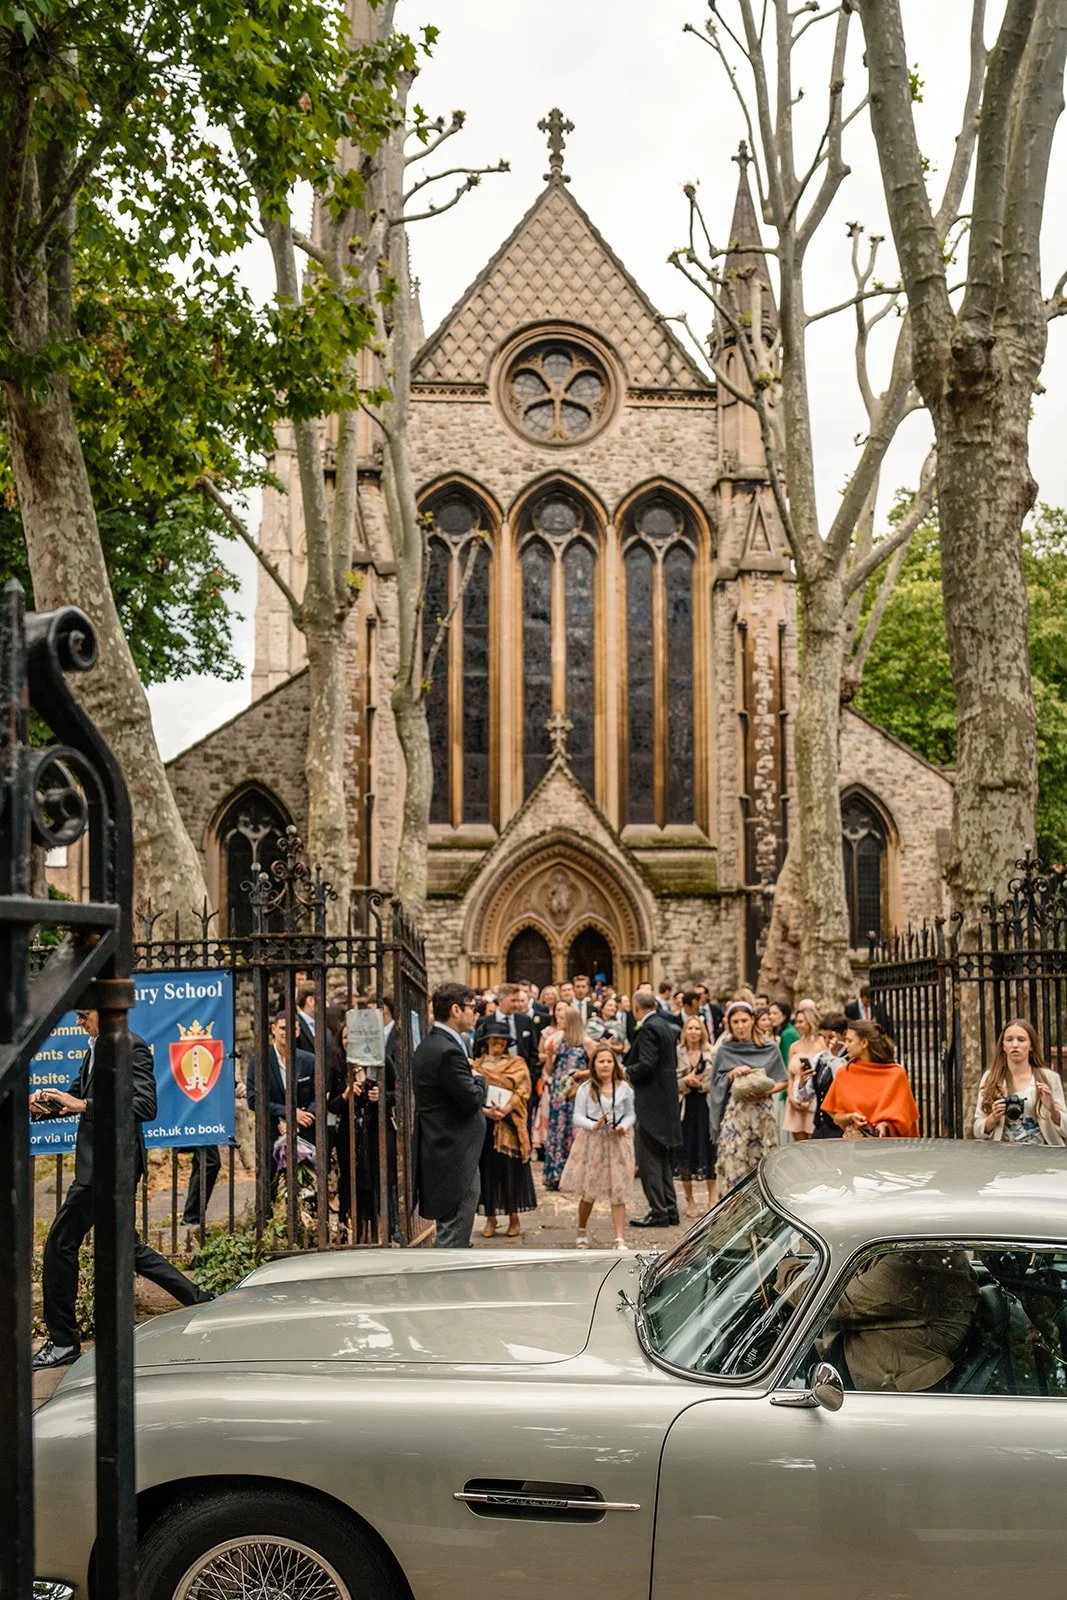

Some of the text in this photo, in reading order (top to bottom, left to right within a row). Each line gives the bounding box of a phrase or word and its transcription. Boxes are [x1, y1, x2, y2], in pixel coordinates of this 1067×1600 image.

[164, 981, 222, 1000] School
[143, 1123, 226, 1138] .sch.uk to book
[30, 1136, 42, 1144] or
[44, 1133, 61, 1144] via
